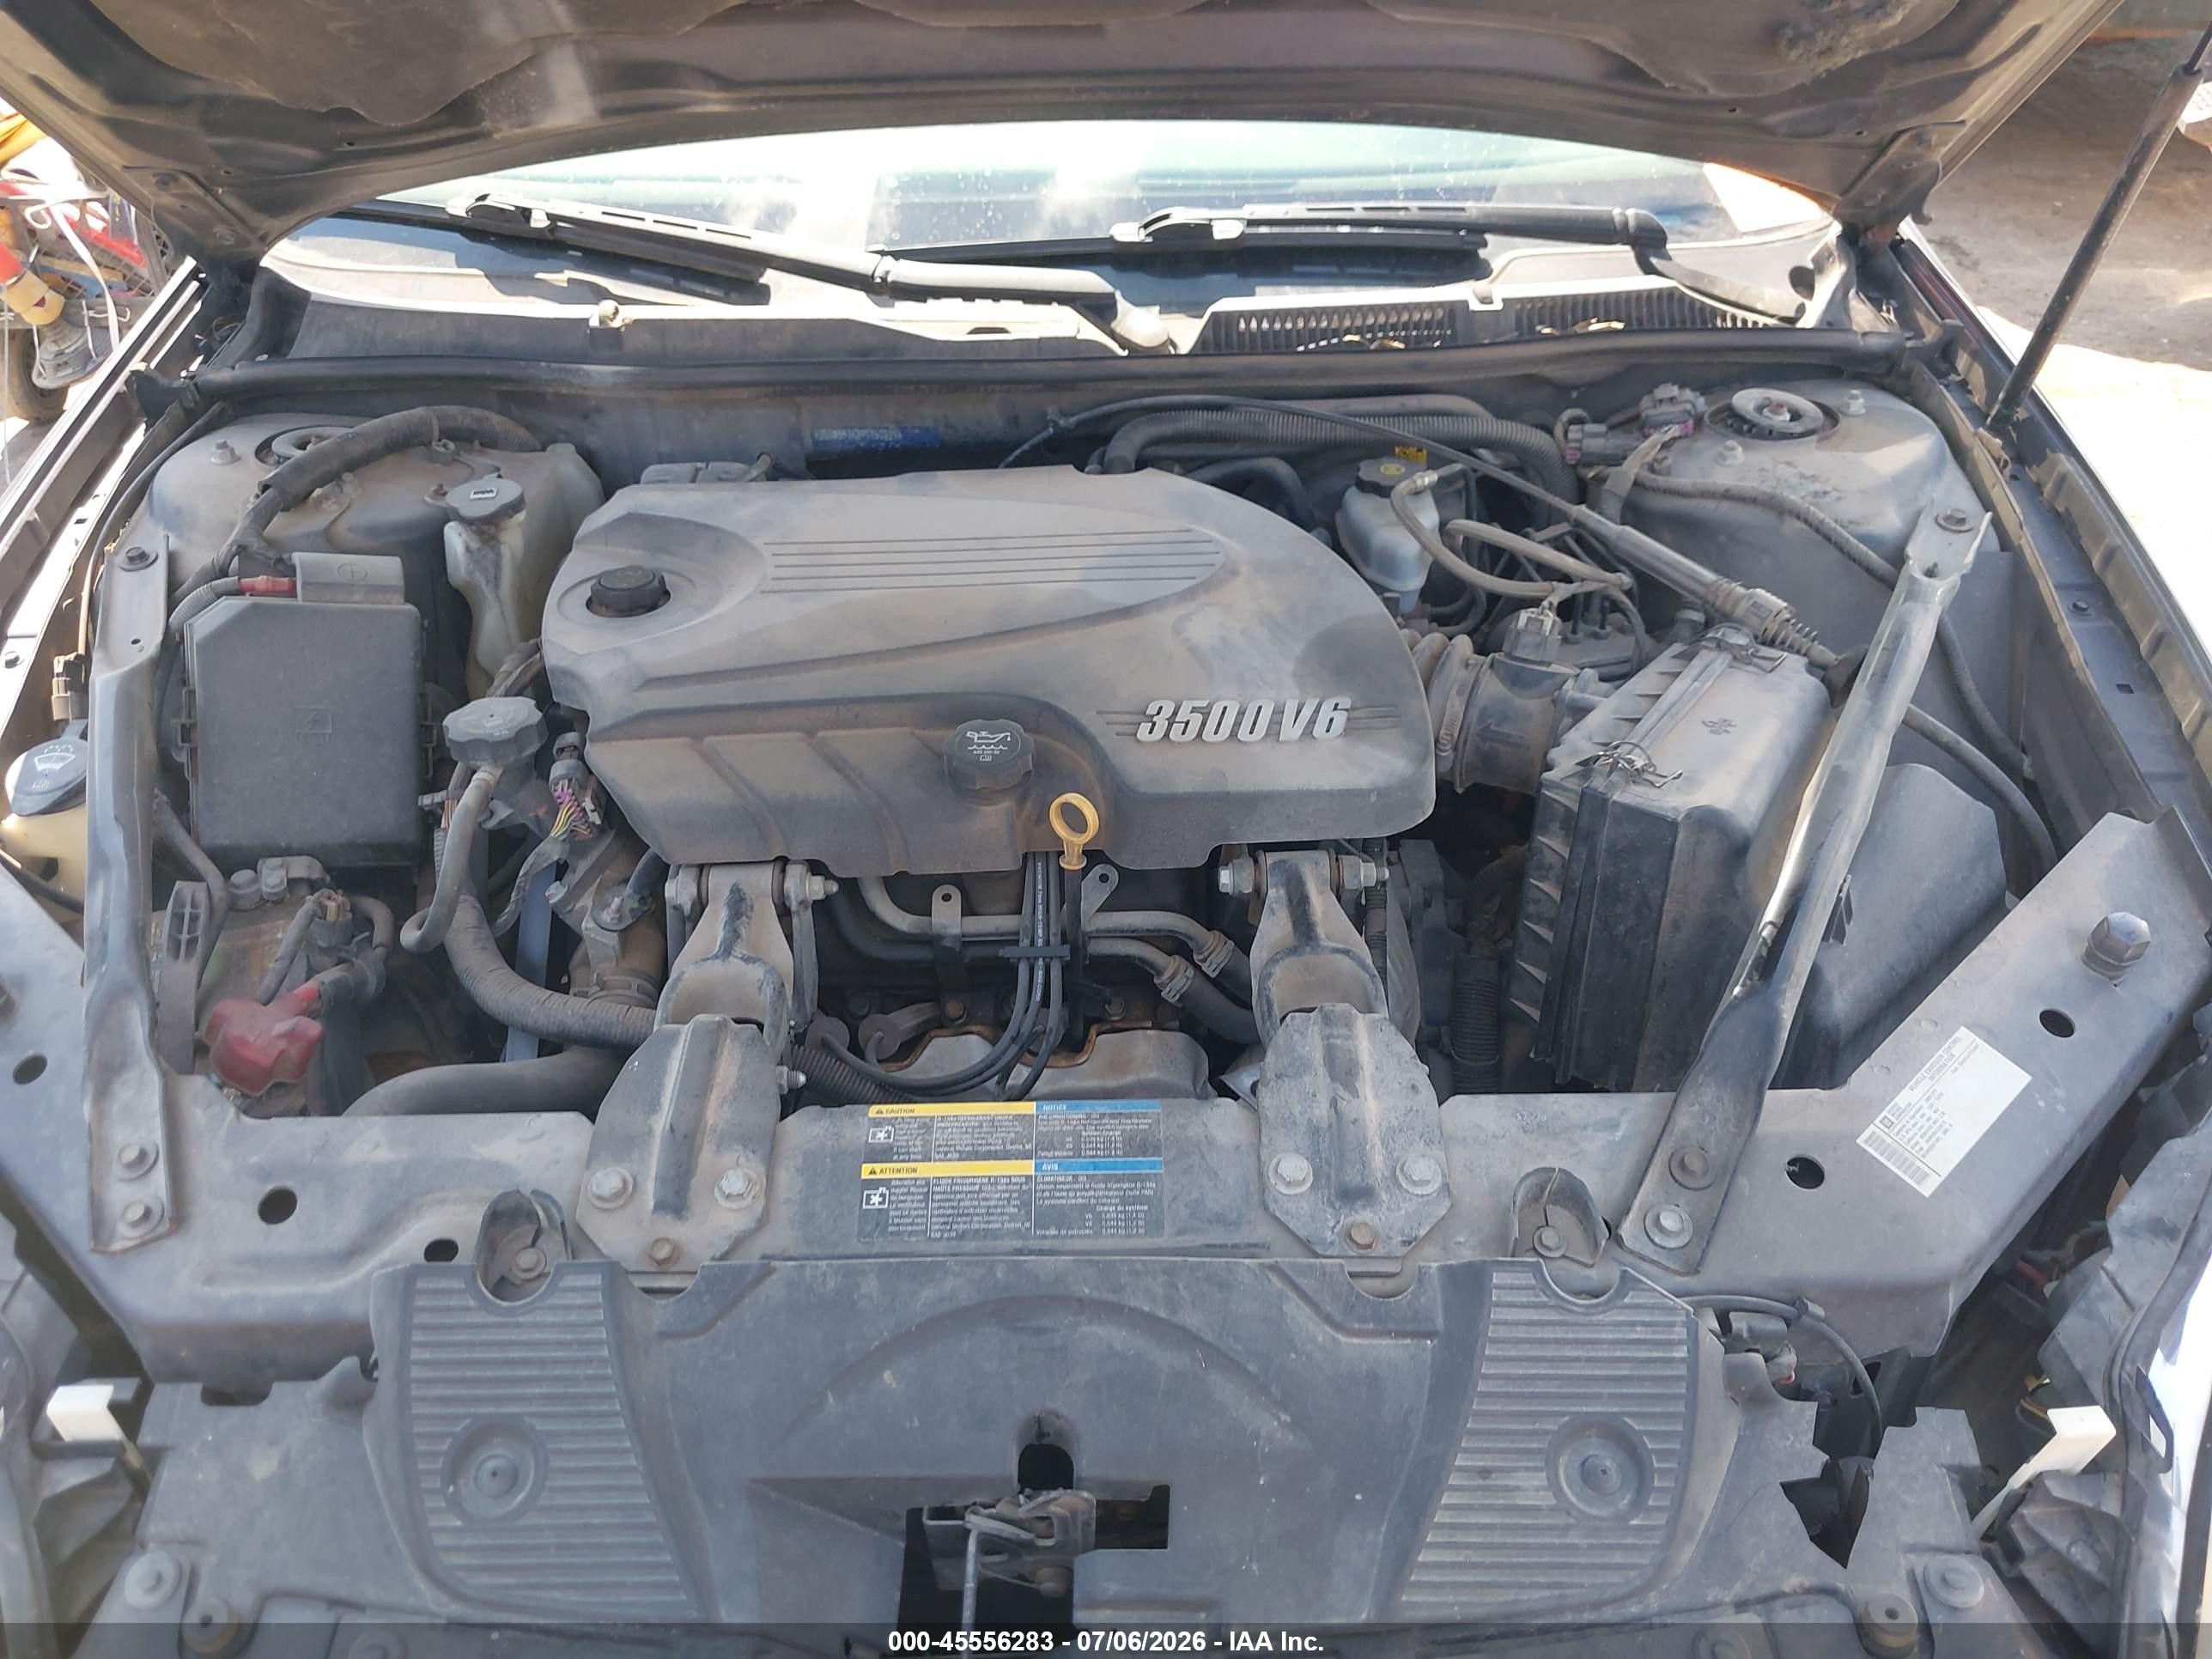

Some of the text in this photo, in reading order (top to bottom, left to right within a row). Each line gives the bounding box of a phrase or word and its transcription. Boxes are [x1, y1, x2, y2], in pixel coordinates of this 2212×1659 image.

[1136, 697, 1352, 742] 3500 V6
[878, 1166, 918, 1176] ATTENTION
